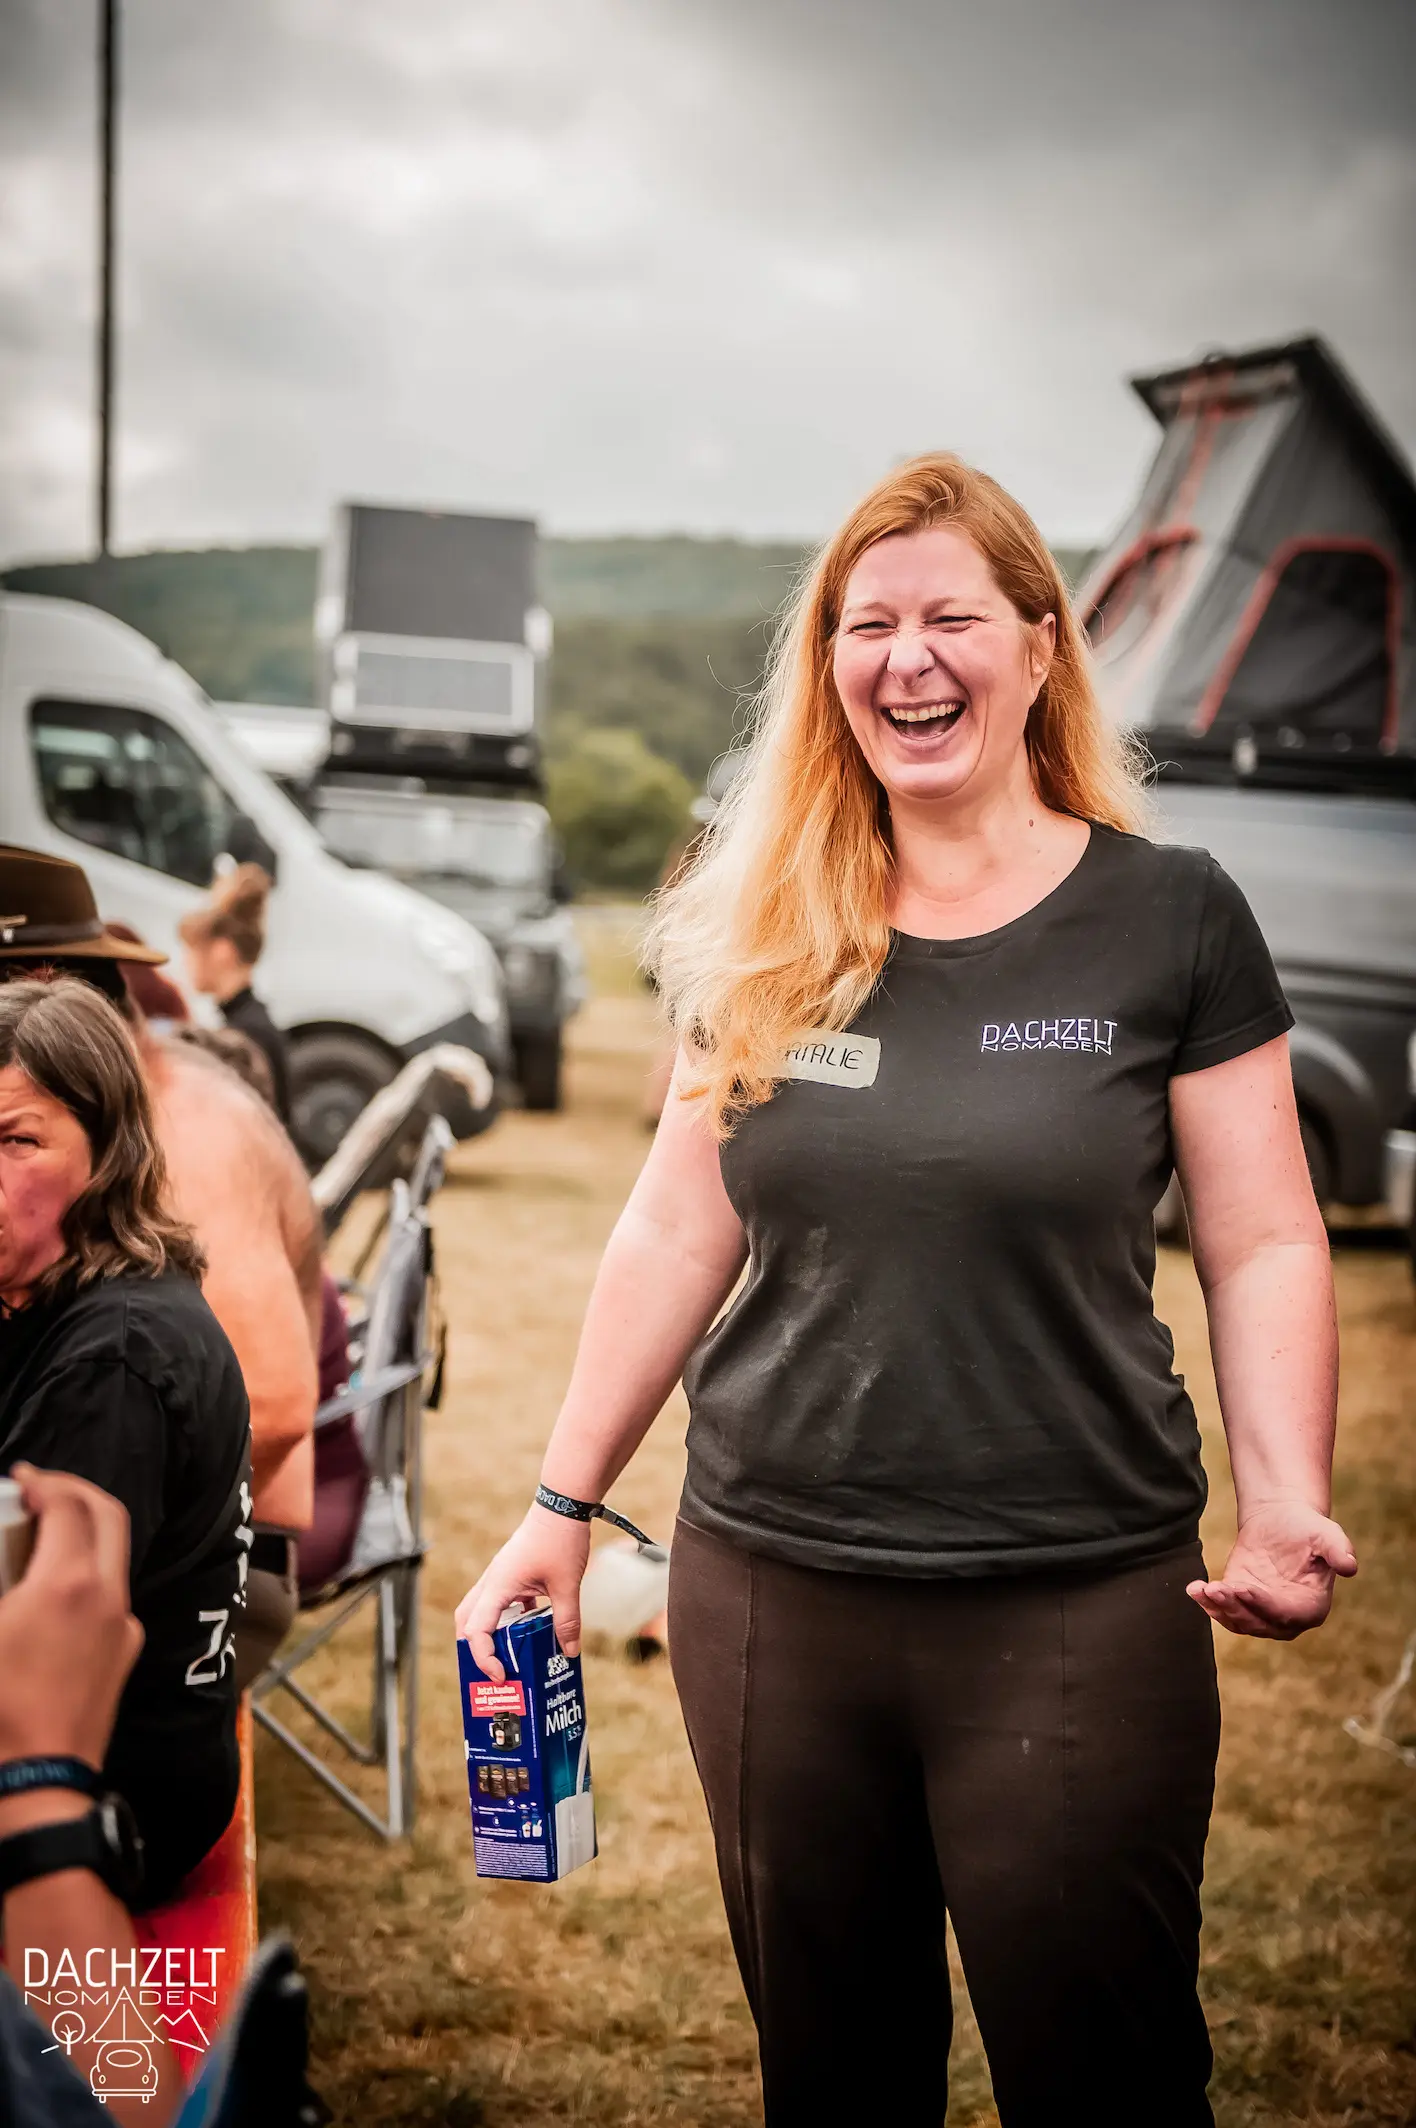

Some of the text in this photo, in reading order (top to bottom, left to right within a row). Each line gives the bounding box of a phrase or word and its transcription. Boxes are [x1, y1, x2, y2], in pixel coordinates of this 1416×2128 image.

[982, 1018, 1118, 1046] DACHZELT
[779, 1040, 864, 1070] ATALIE
[980, 1040, 1113, 1056] NOMADEN
[545, 1700, 582, 1737] Milch
